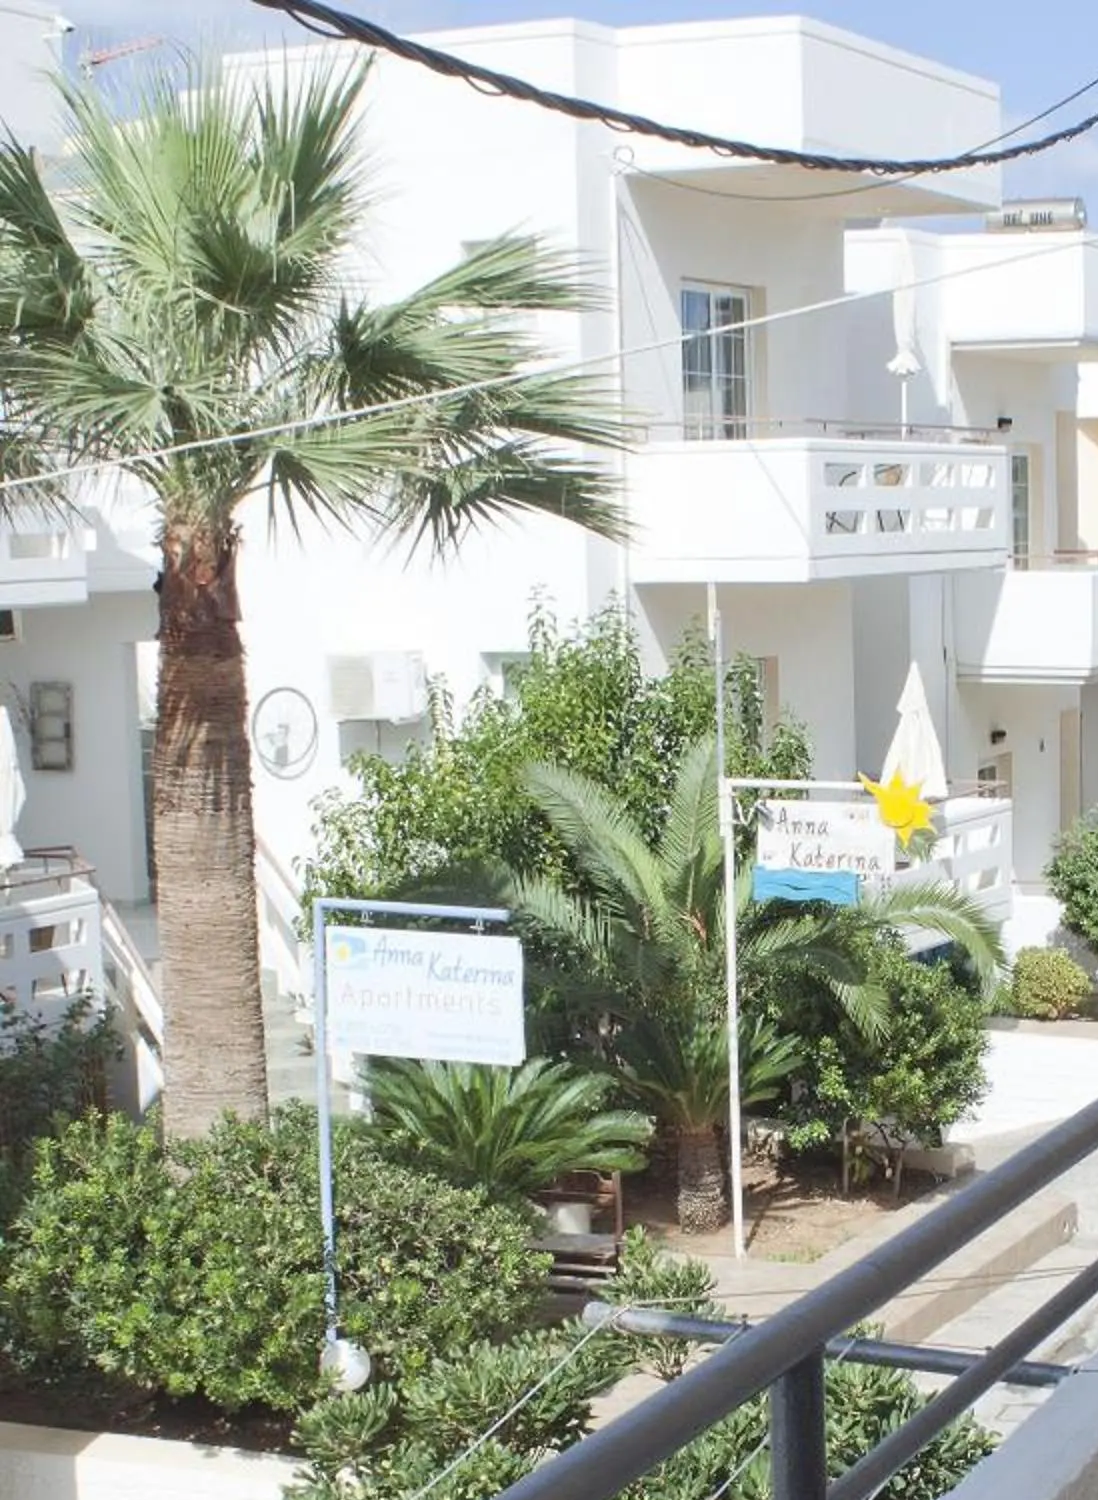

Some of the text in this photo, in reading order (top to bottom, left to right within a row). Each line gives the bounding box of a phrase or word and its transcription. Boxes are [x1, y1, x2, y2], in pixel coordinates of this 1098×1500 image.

[777, 807, 829, 836] Anna
[373, 934, 424, 967] Anna
[341, 982, 502, 1016] Apartments
